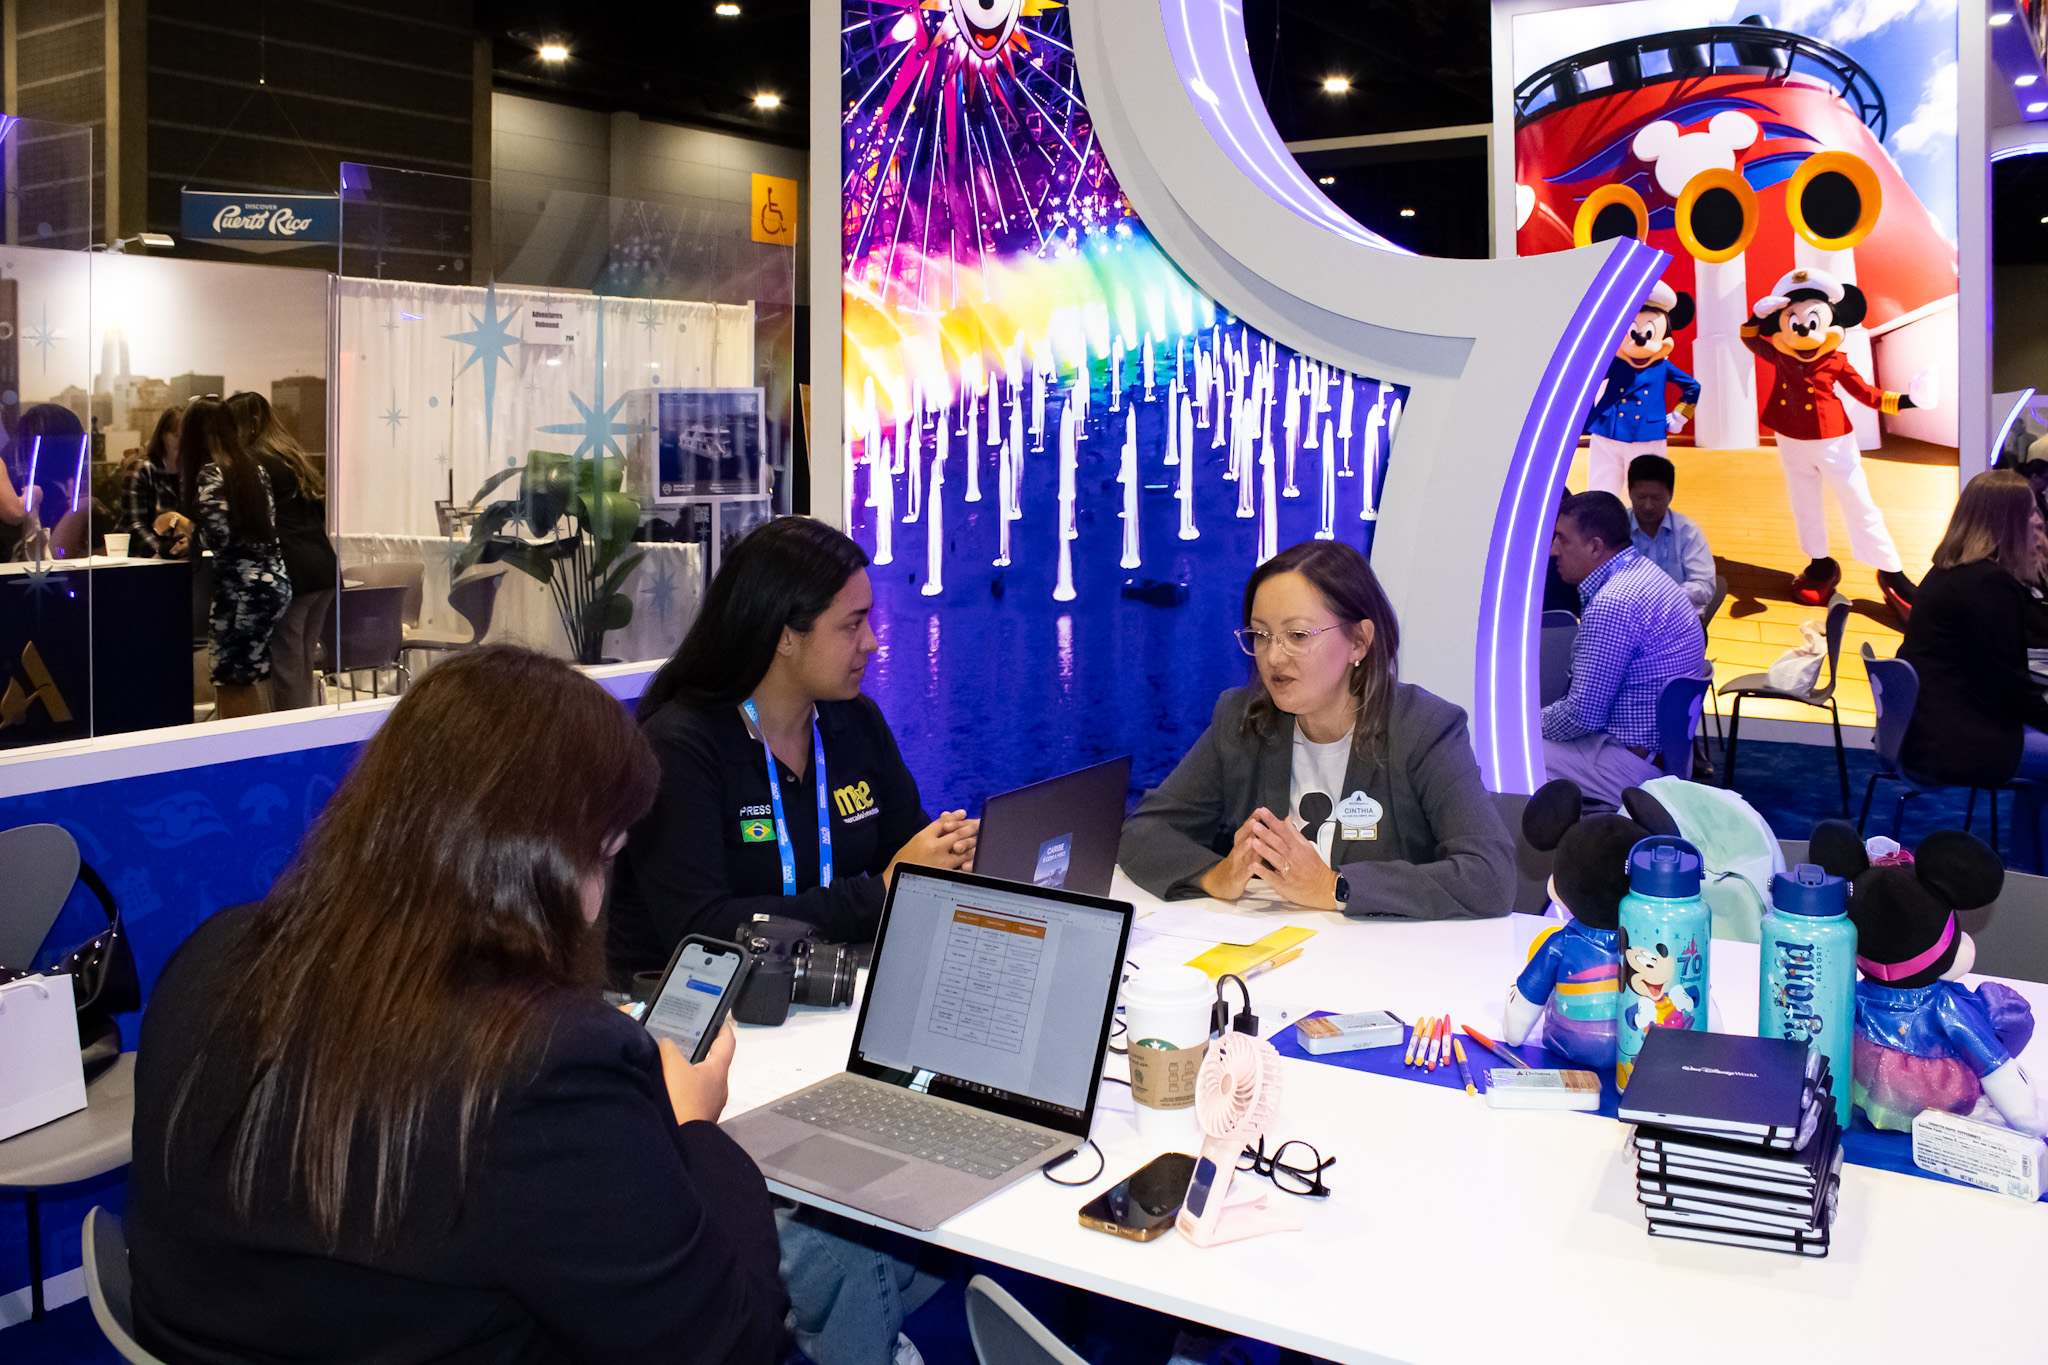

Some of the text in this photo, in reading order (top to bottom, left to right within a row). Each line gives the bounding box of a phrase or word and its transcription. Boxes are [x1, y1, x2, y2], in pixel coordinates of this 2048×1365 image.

[212, 205, 312, 236] Puerto Rico
[740, 804, 771, 816] PRESS
[1677, 954, 1703, 976] 70
[1815, 946, 1823, 982] RESORT
